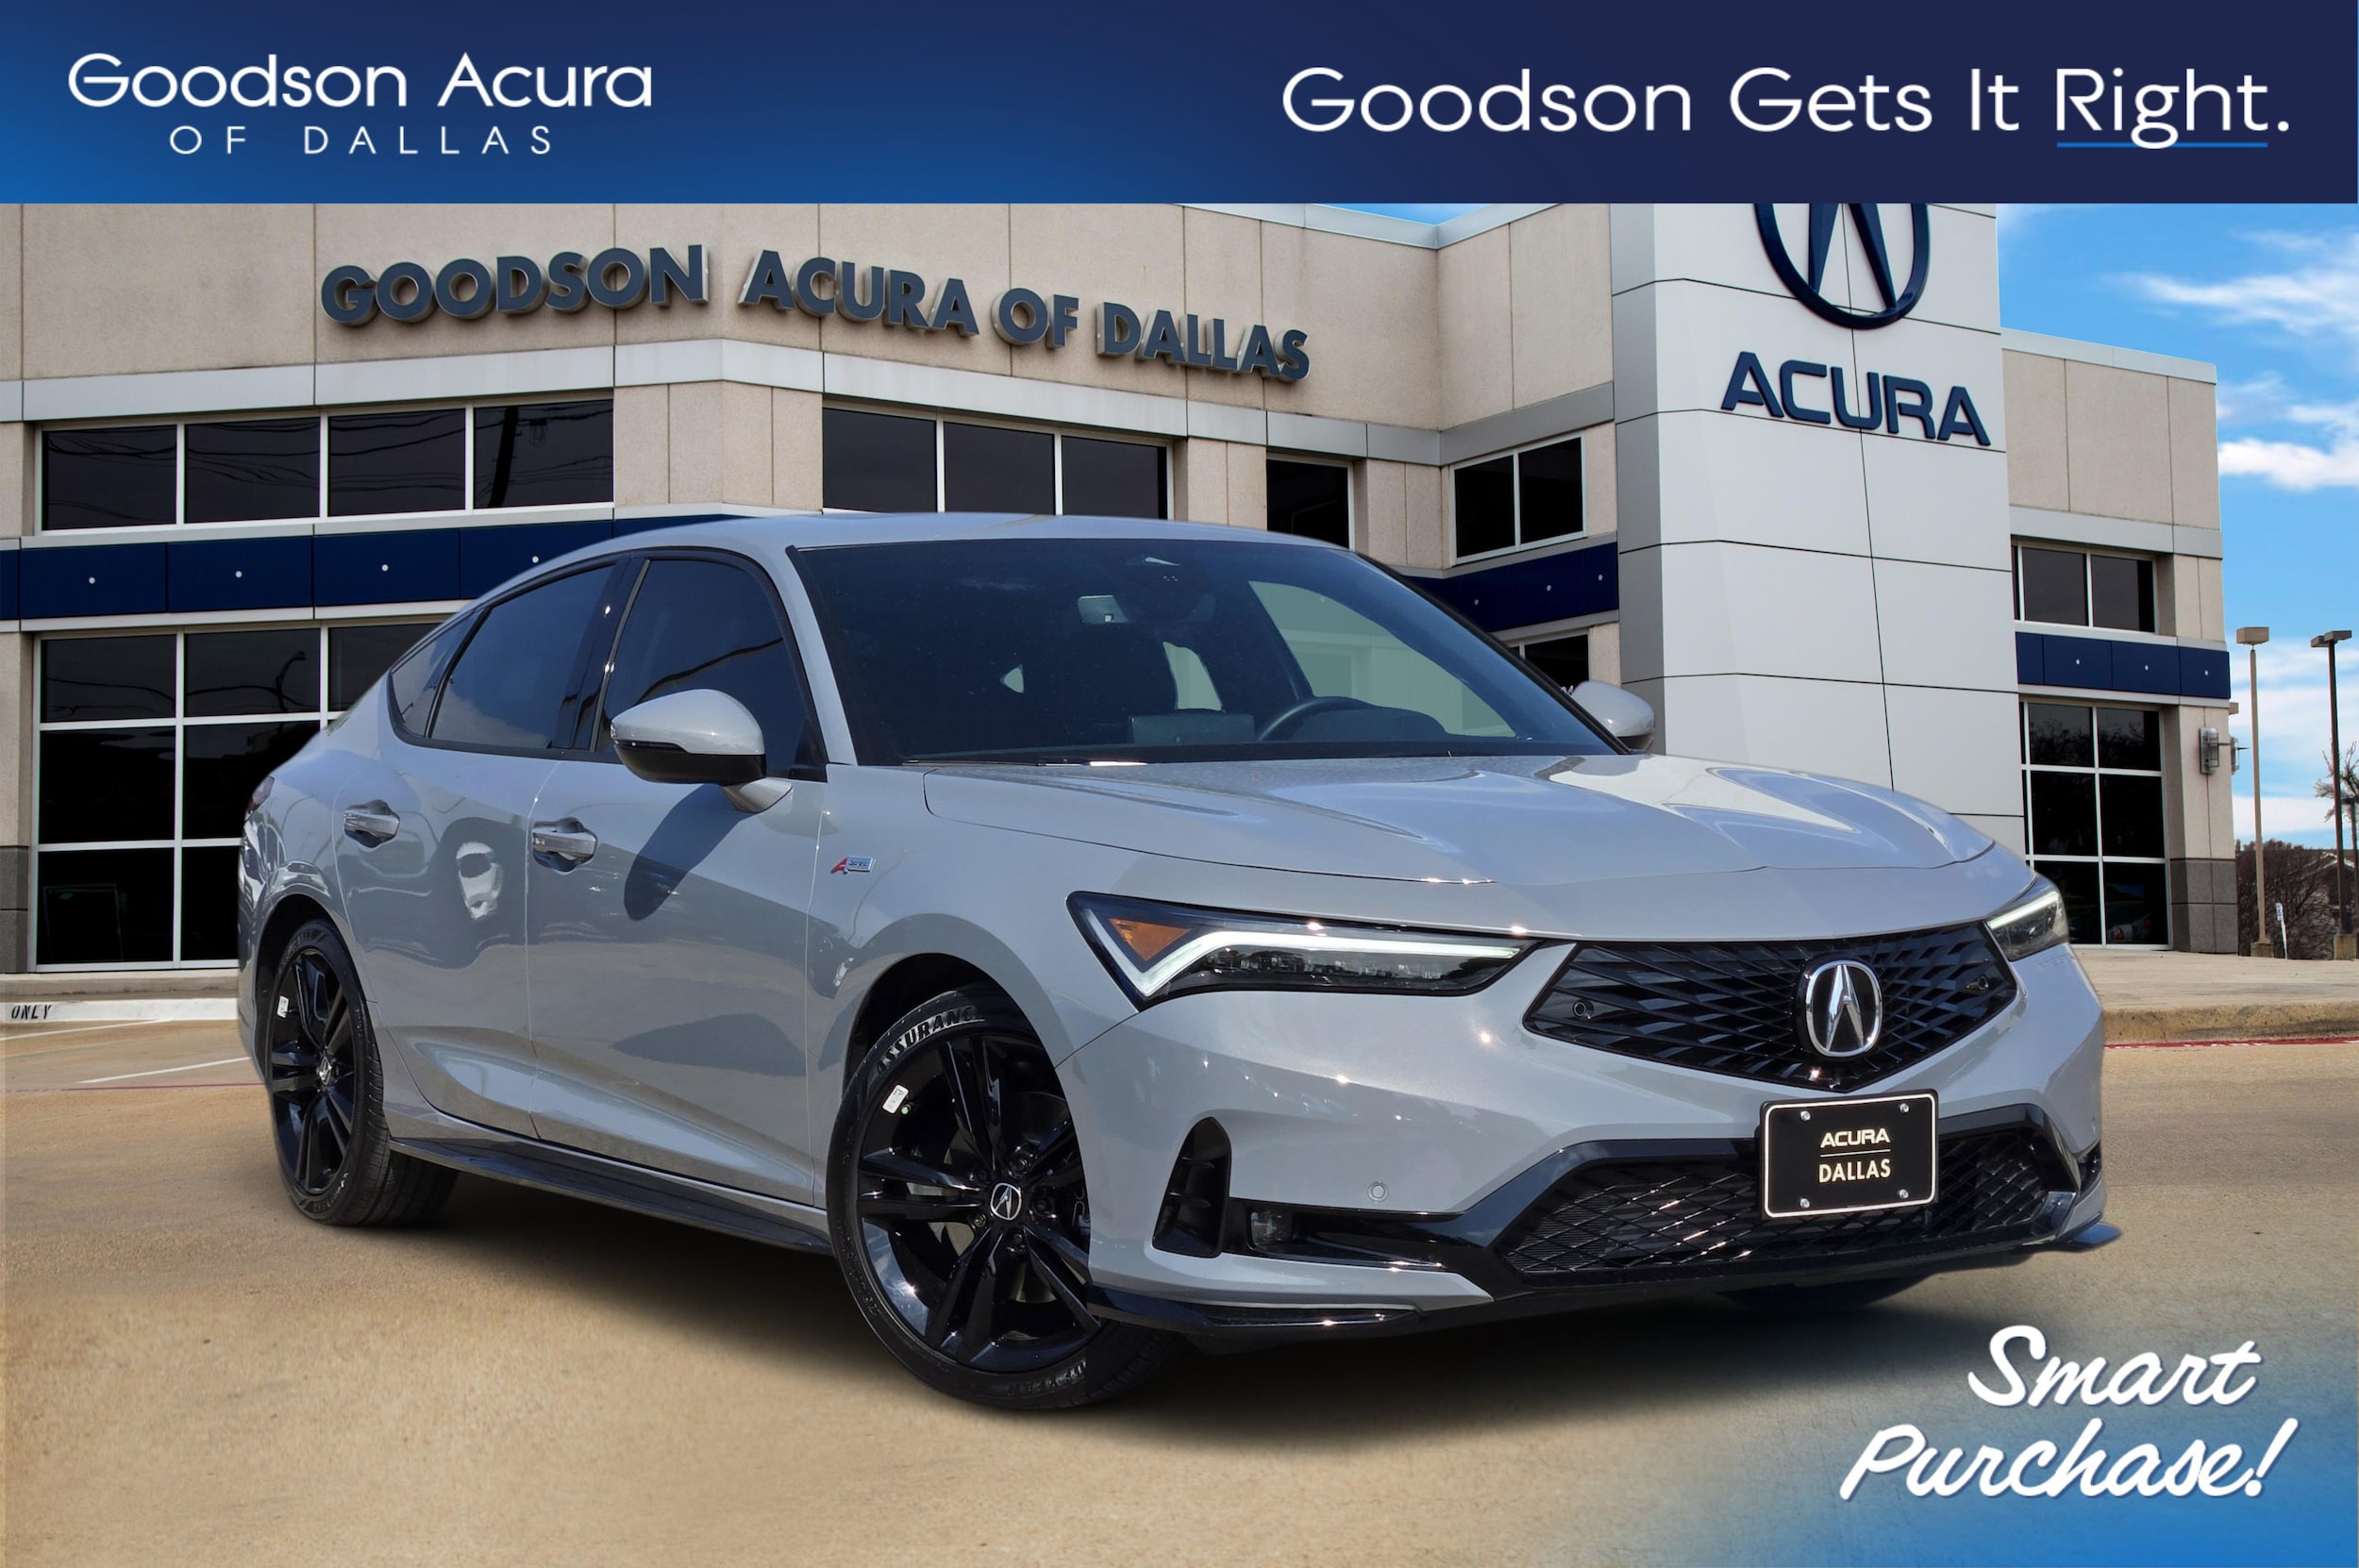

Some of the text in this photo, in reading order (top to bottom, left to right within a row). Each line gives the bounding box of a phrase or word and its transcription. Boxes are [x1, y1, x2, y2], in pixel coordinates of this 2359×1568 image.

[321, 244, 1310, 381] GOODSON ACURA OF DALLAS
[1720, 351, 1991, 447] ACURA
[10, 1003, 53, 1020] ONLY
[1819, 1127, 1891, 1148] ACURA
[1818, 1158, 1891, 1183] DALLAS
